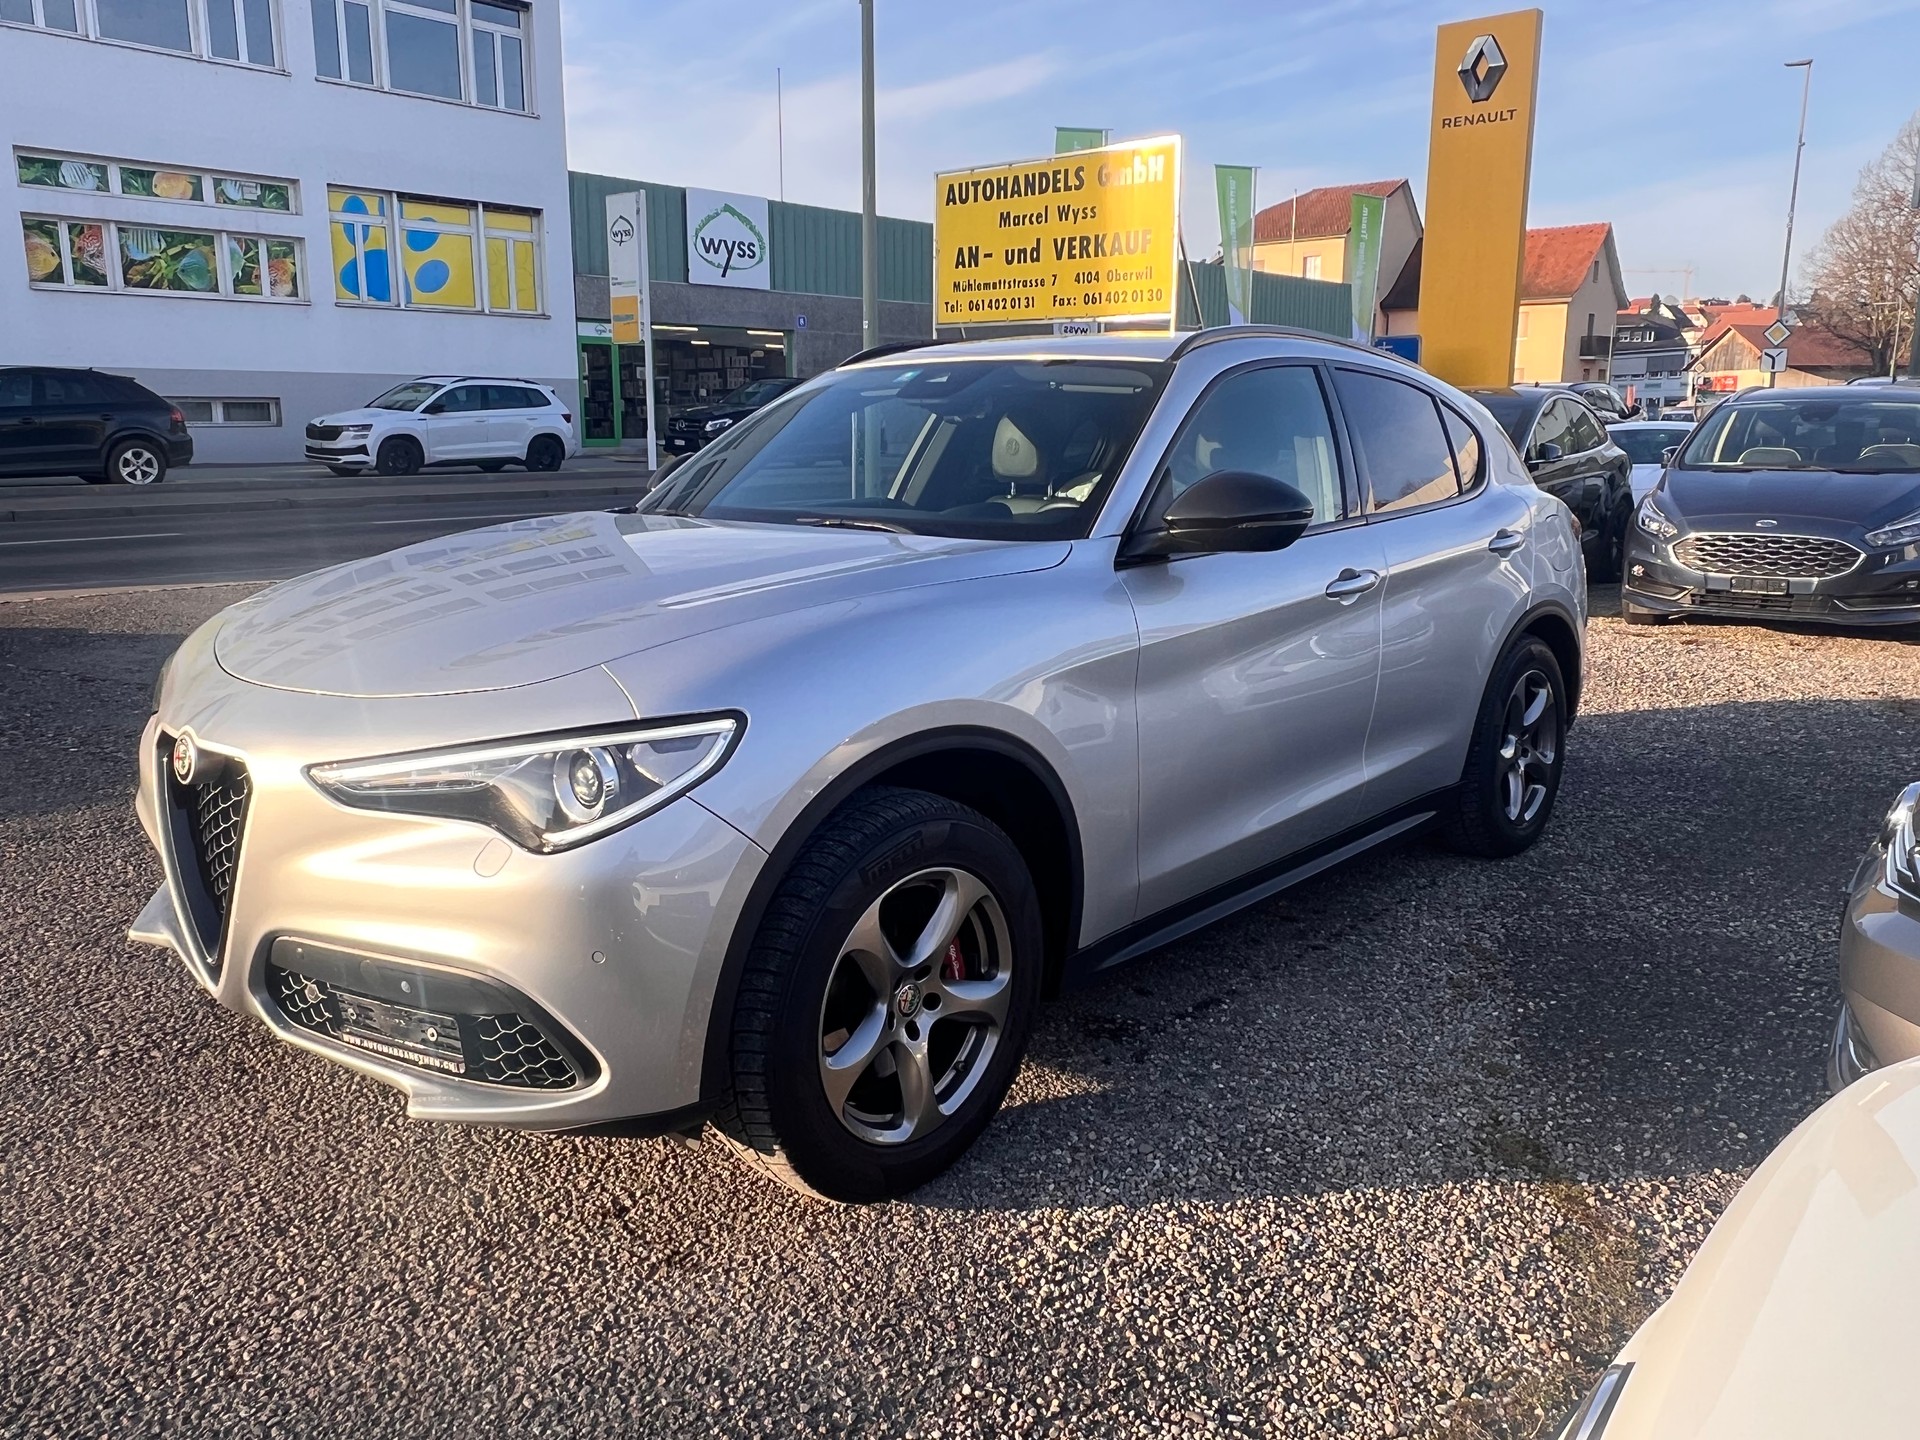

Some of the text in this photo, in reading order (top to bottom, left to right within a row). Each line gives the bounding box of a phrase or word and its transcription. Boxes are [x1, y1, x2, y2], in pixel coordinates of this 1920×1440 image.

[1442, 108, 1518, 129] RENAULT
[945, 153, 1165, 206] AUTOHANDELS GmbH
[999, 204, 1097, 228] Marcel Wyss
[700, 236, 756, 278] wyss
[1005, 238, 1041, 265] und
[1053, 229, 1151, 261] VERKAUF
[953, 265, 1153, 293] Mühlemattstrasse 7 4104 Oberwil
[944, 300, 963, 313] Tel:
[1052, 294, 1077, 307] Fax:
